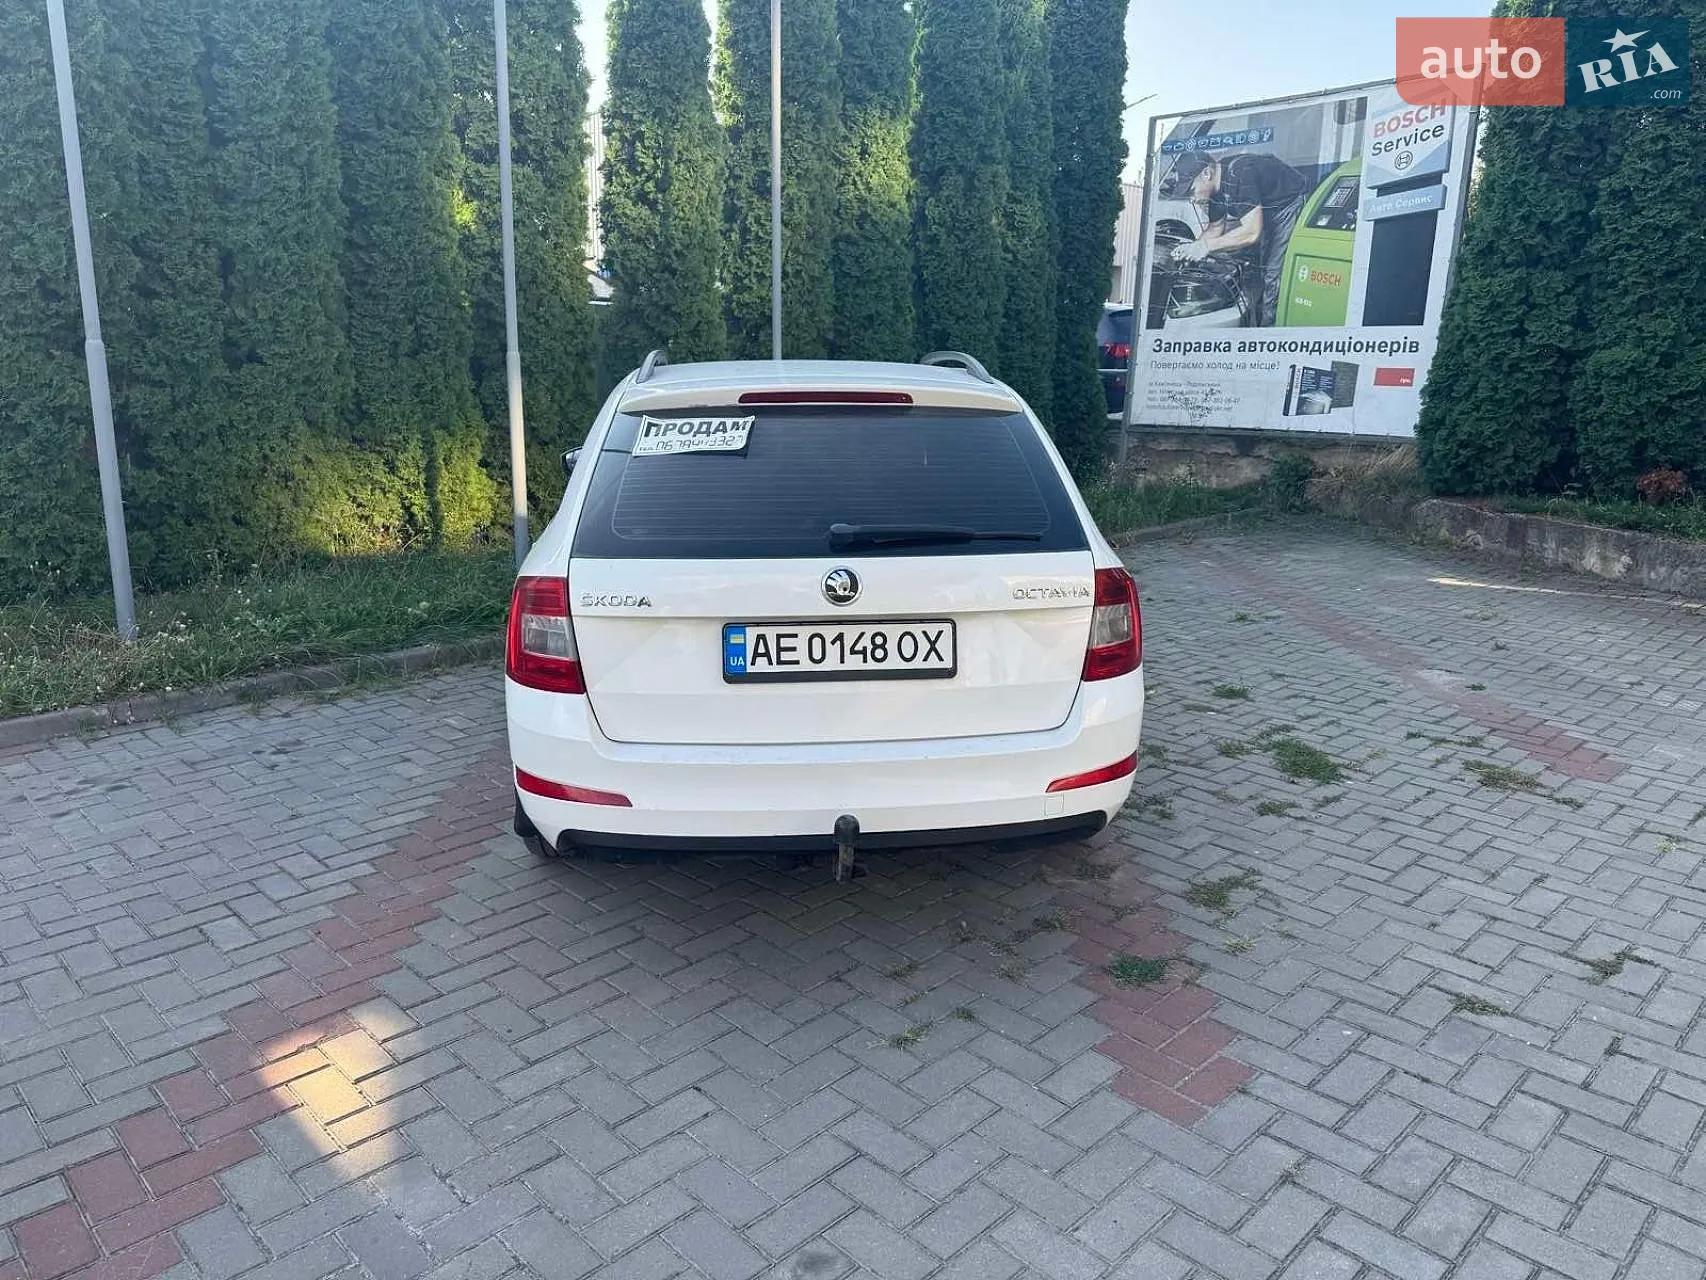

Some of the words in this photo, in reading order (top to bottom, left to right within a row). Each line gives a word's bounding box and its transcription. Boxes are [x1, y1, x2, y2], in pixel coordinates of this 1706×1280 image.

[1373, 99, 1447, 138] BOSCH
[1371, 124, 1445, 156] Service
[1311, 271, 1342, 287] BOSCH
[1152, 338, 1232, 356] Заправка
[1237, 336, 1421, 357] автокондиціонерів
[1150, 360, 1204, 371] Повертаємо
[1206, 360, 1233, 370] холод
[1236, 361, 1247, 370] на
[644, 421, 749, 437] ПРОДАМ
[1012, 586, 1090, 599] OCTAVIA
[750, 632, 800, 666] AE
[808, 631, 889, 665] 0148
[897, 630, 945, 663] OX
[730, 656, 745, 666] UA
